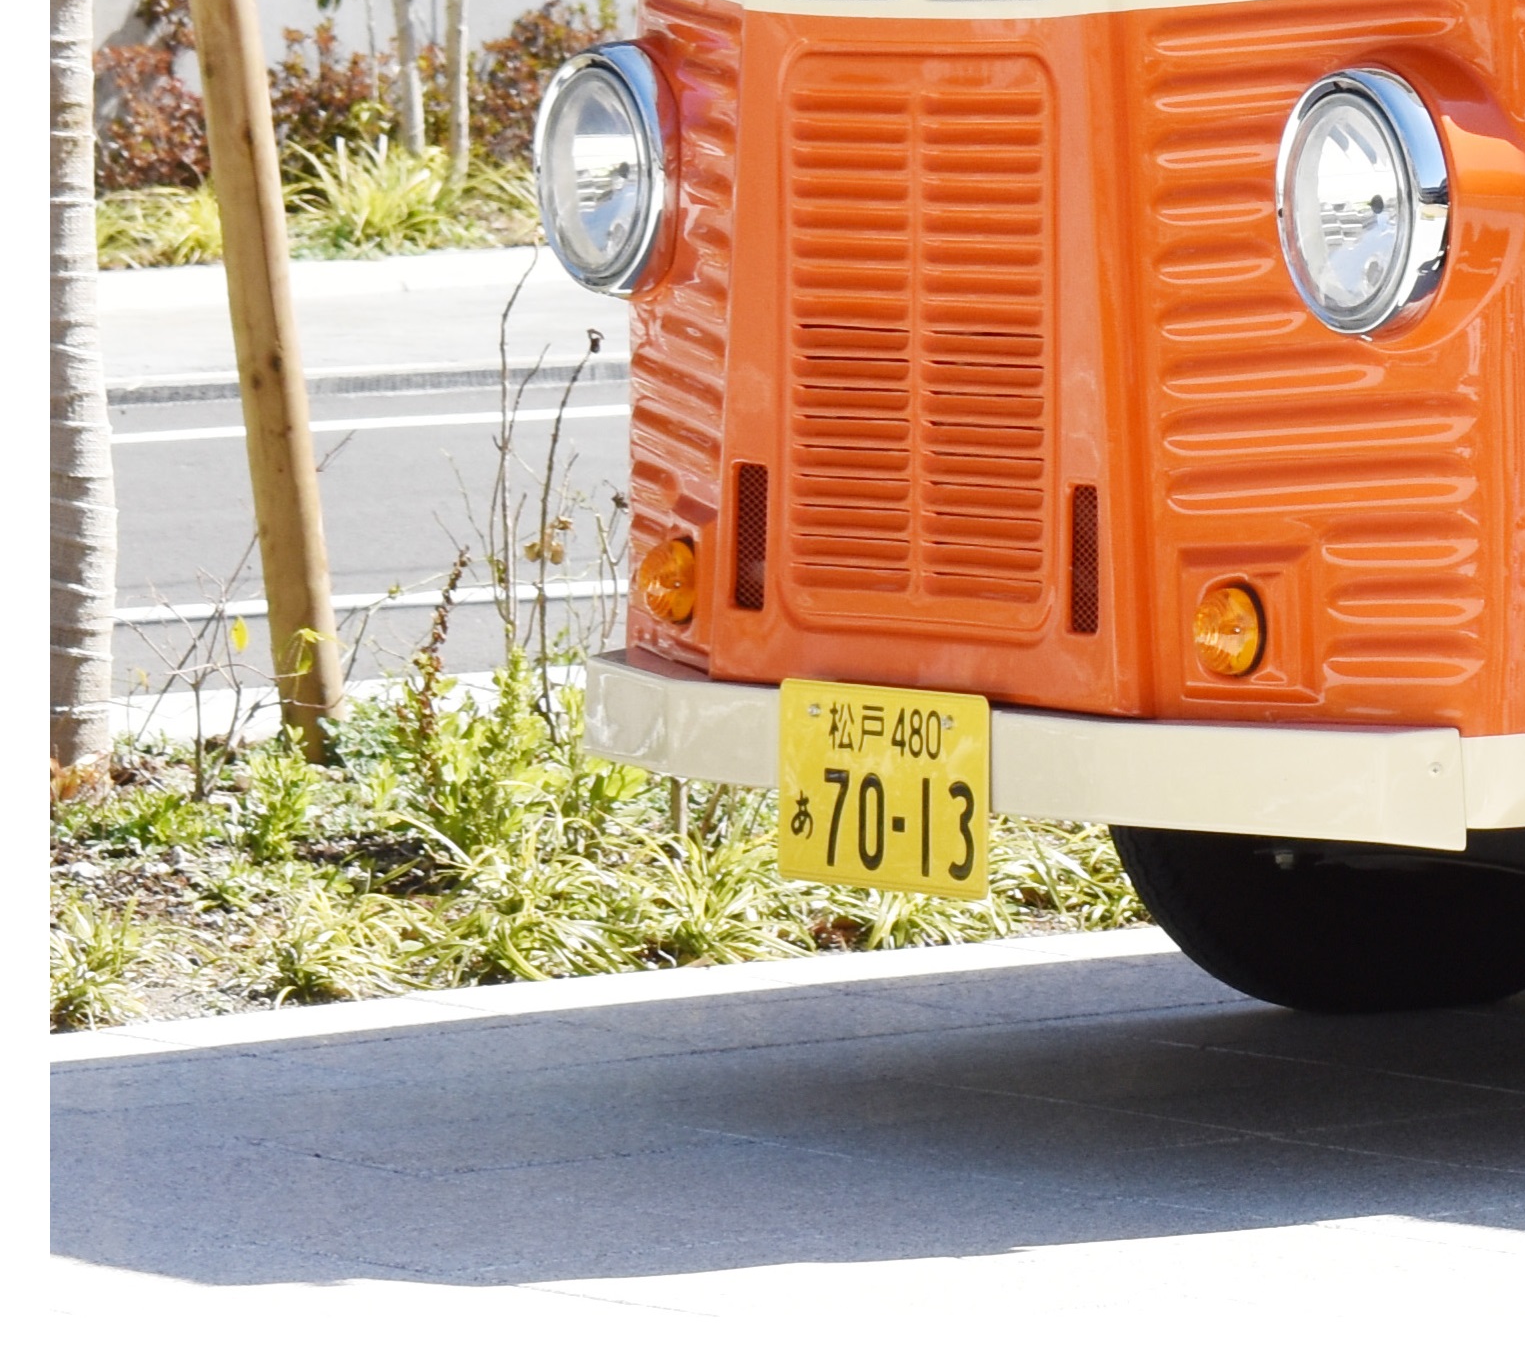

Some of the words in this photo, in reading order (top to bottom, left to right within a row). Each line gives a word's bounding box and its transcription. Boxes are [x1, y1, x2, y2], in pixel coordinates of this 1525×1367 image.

[829, 701, 884, 752] 松戸
[891, 707, 942, 760] 480
[791, 790, 813, 839] あ
[824, 768, 974, 881] 70-13
